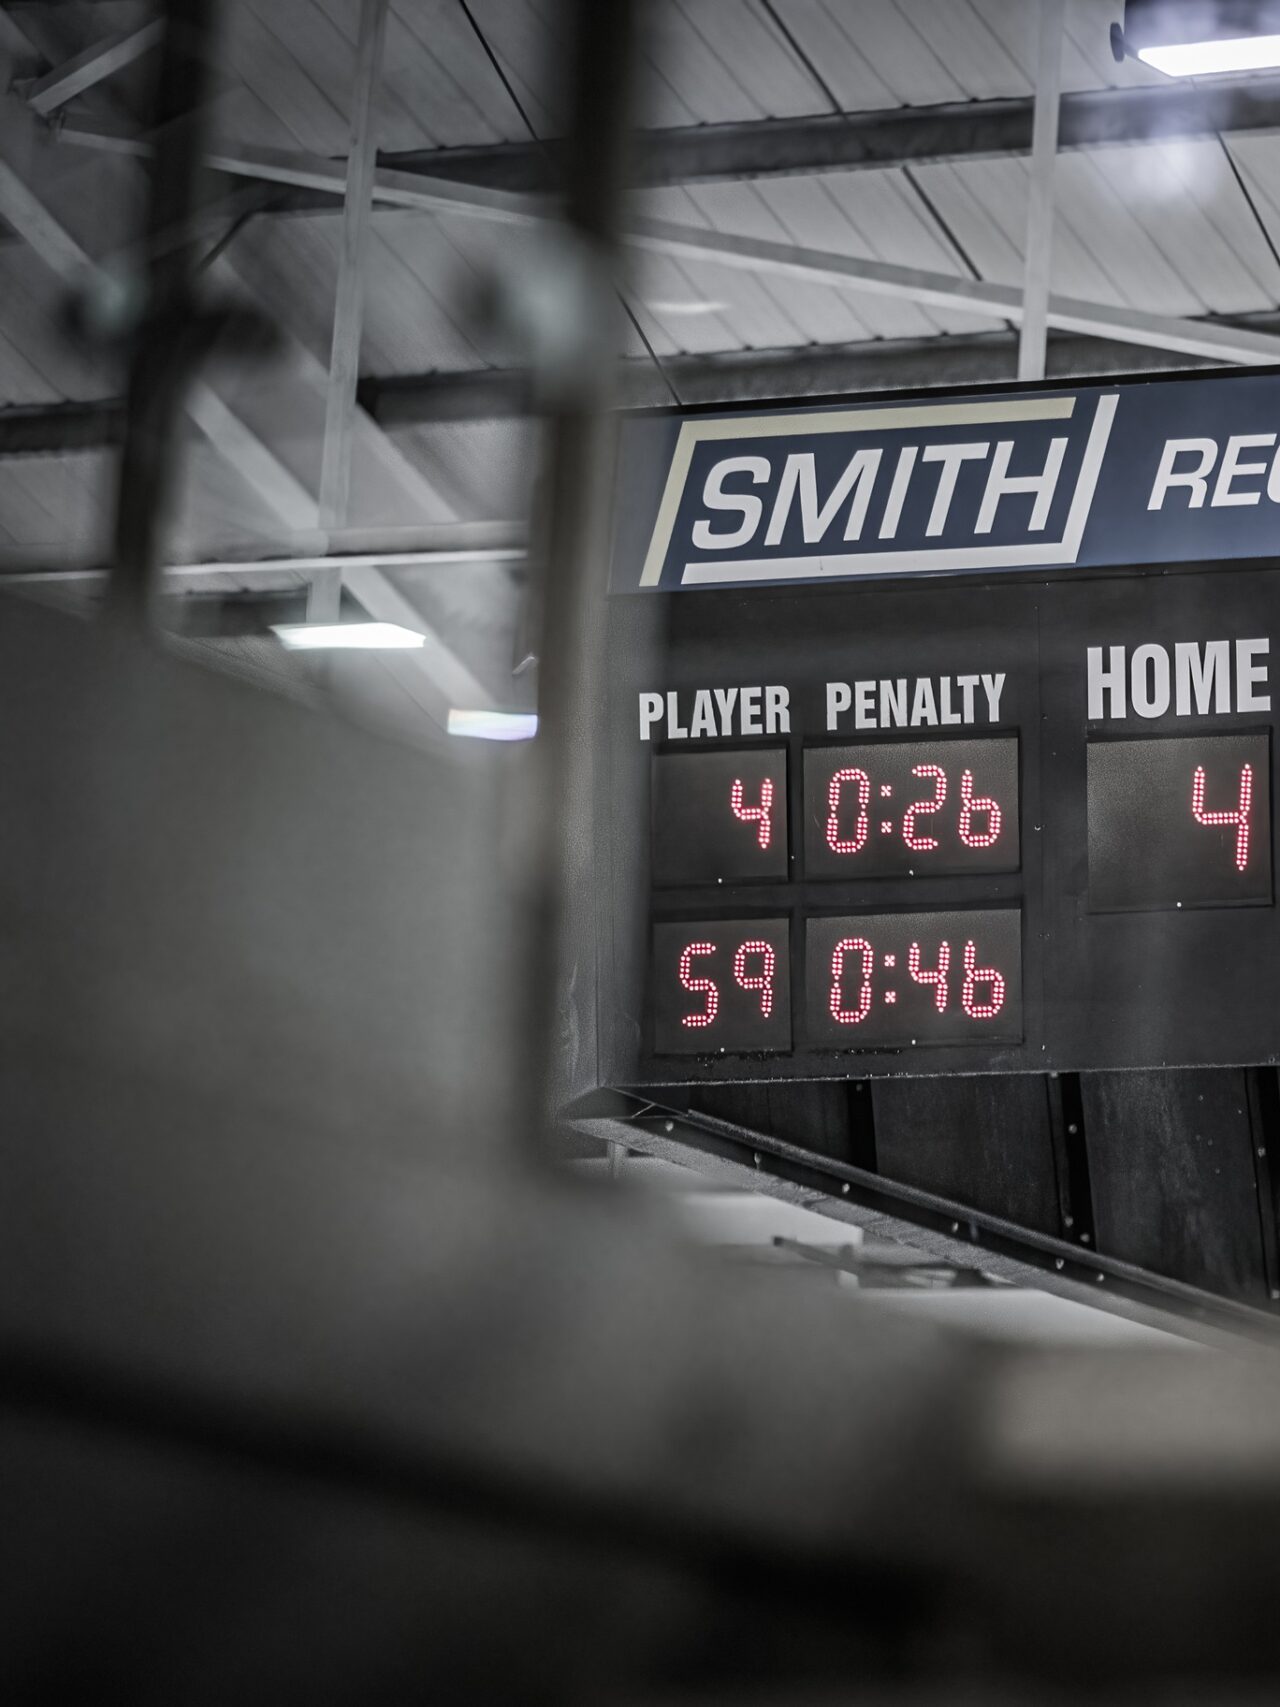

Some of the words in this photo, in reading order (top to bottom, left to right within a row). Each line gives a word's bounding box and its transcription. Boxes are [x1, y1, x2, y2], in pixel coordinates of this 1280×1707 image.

[691, 437, 1068, 549] SMITH
[639, 685, 791, 740] PLAYER
[826, 673, 1006, 731] PENALTY
[1086, 638, 1271, 719] HOME
[731, 777, 774, 849] 4
[826, 764, 1002, 854] 0:26
[1192, 763, 1252, 871] 4
[680, 940, 776, 1027] 59
[829, 938, 1005, 1024] 0:46
